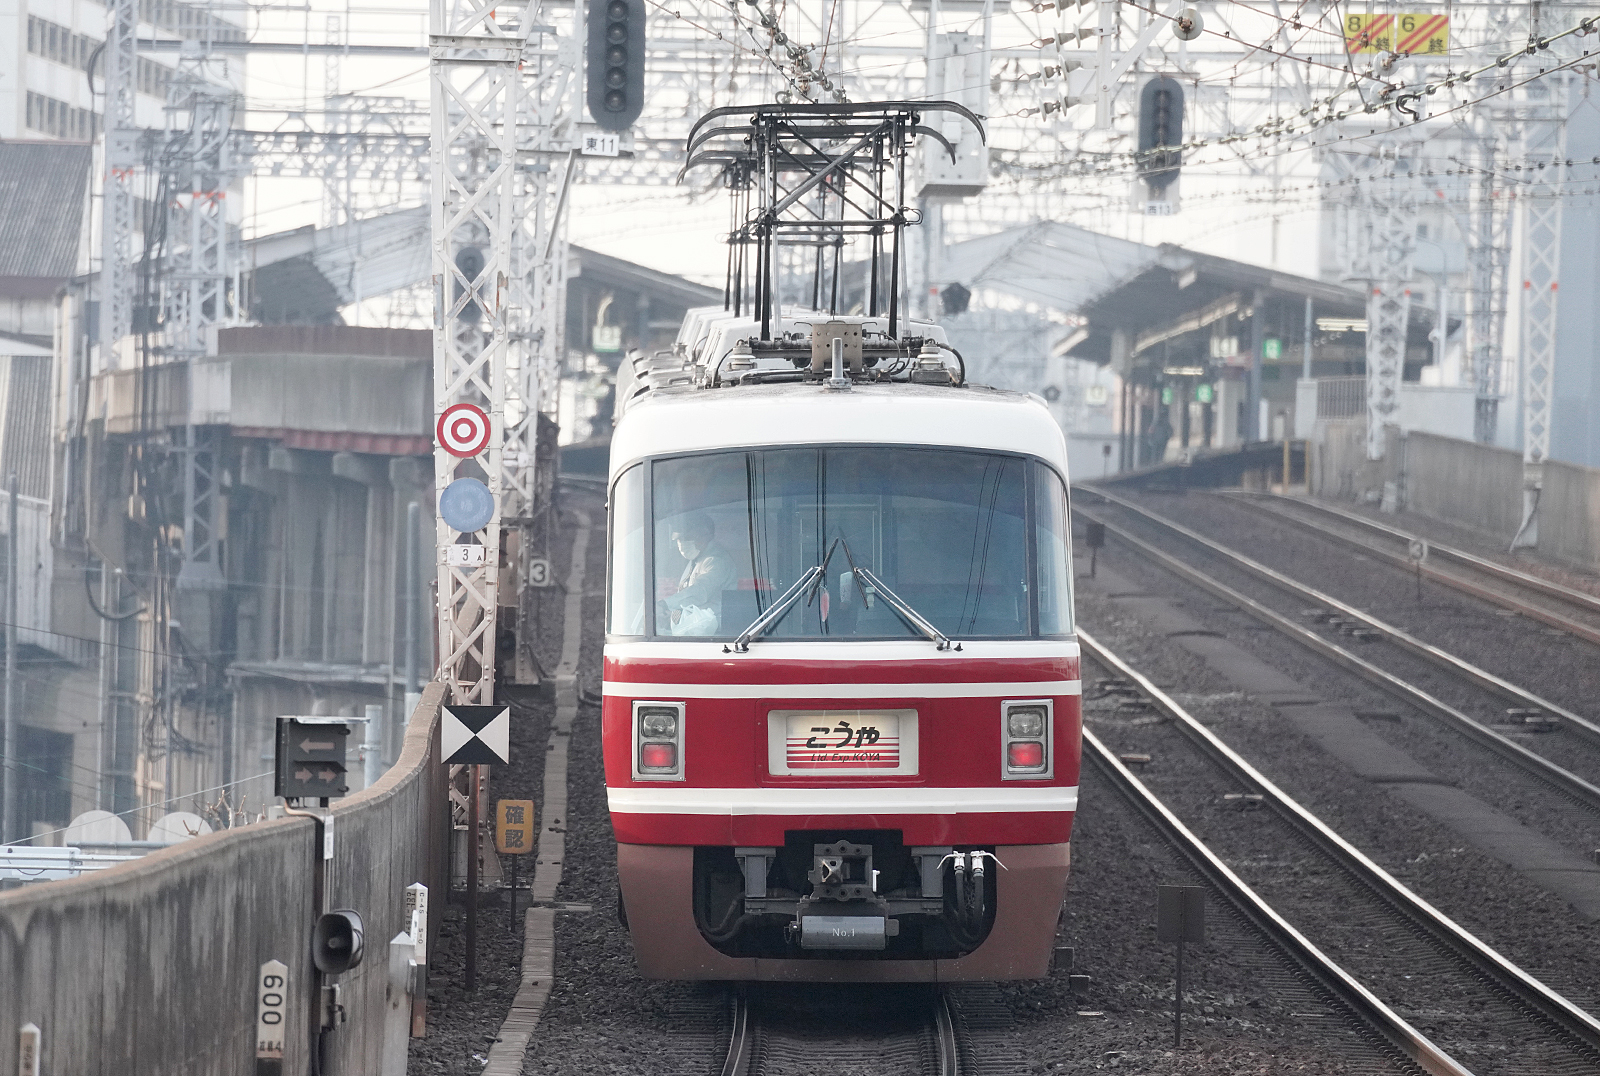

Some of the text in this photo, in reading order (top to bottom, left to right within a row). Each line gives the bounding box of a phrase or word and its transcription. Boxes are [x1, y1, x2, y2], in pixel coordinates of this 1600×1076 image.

[1347, 16, 1361, 32] 8
[1402, 16, 1415, 32] 6
[586, 137, 614, 152] 東11
[462, 548, 469, 561] 3
[533, 563, 546, 583] 3
[806, 720, 880, 749] こうや
[811, 753, 828, 762] Ltd.
[831, 753, 850, 764] Exp.
[505, 805, 524, 849] 確認
[832, 928, 855, 937] No.1
[262, 975, 284, 1025] 600
